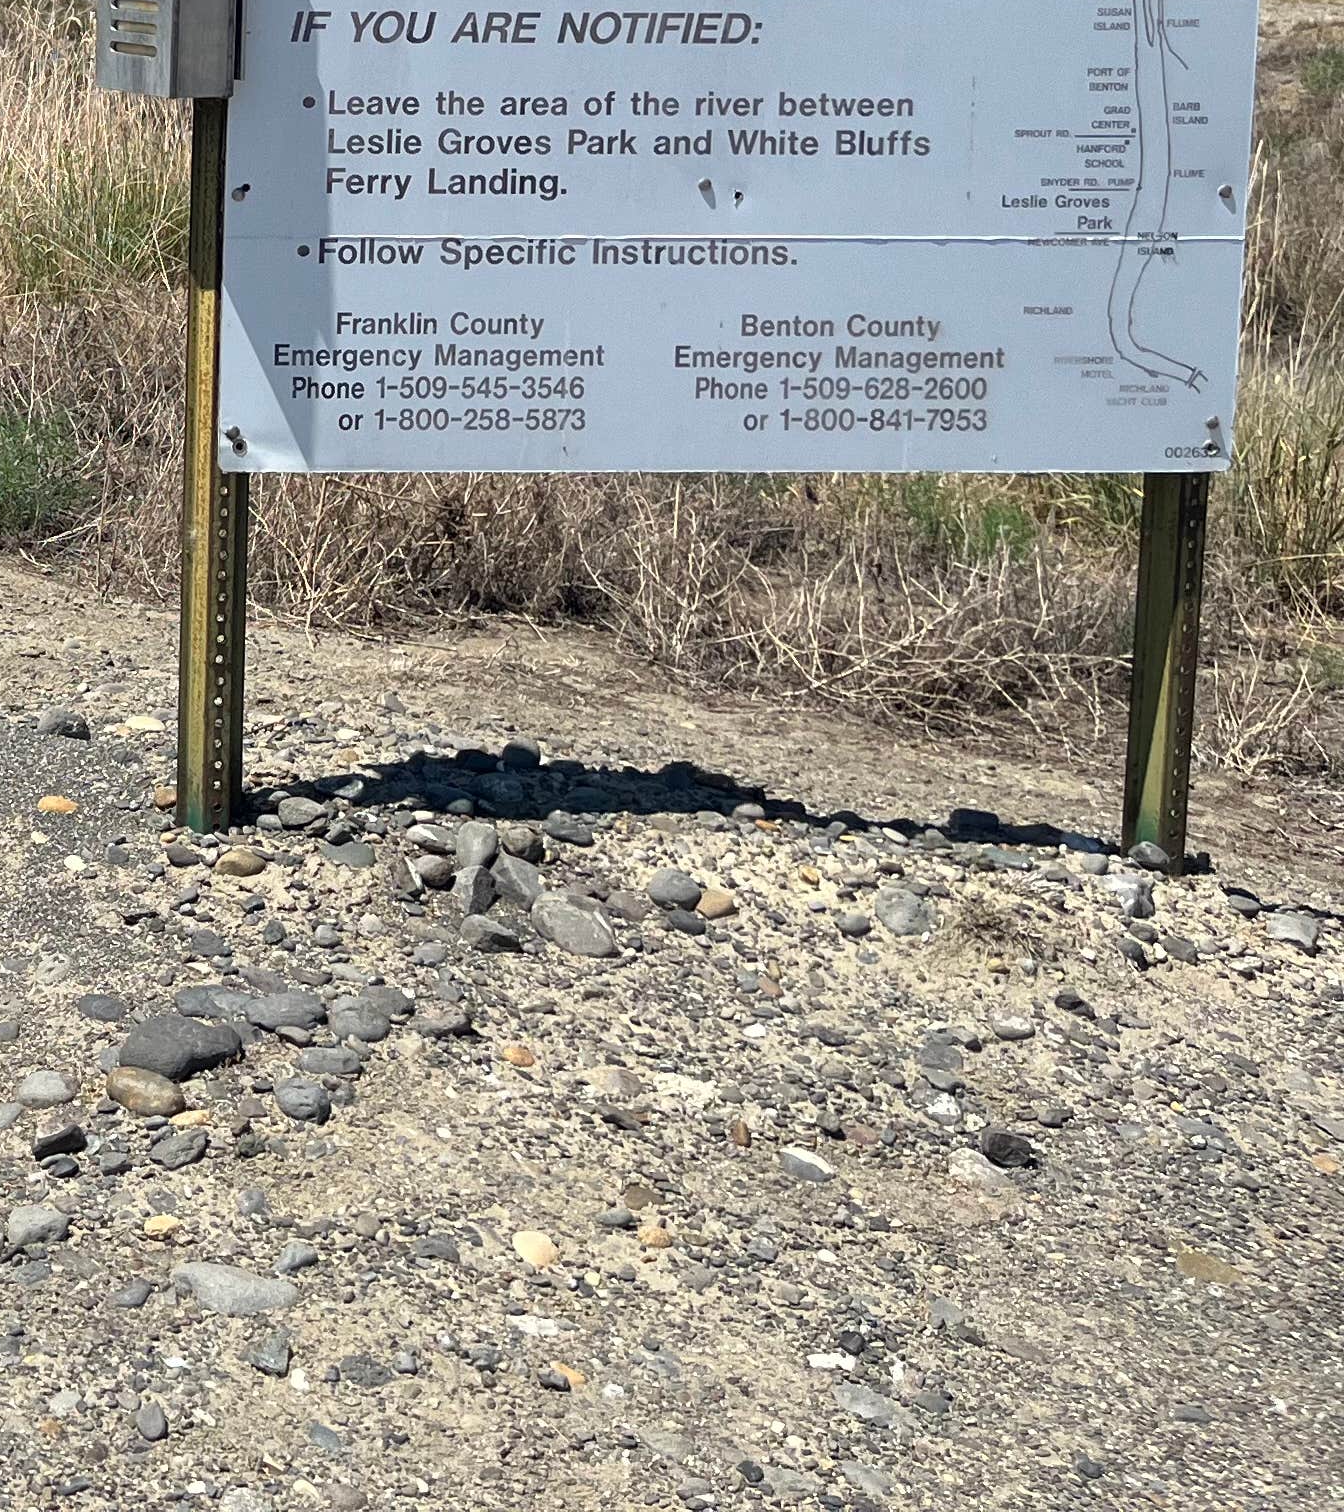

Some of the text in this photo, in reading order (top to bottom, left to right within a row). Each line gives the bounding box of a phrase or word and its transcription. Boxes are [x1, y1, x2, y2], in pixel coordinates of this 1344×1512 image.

[290, 9, 763, 45] IF YOU ARE NOTIFIED:
[1088, 82, 1129, 91] BENTON
[1076, 144, 1127, 154] HANFORD
[1001, 194, 1111, 209] Leslie Groves
[1077, 215, 1113, 230] Park
[336, 310, 545, 339] Franklin County
[273, 342, 605, 373] Emergency Management
[291, 374, 585, 400] Phone 1-509-545-3546
[338, 406, 586, 431] or 1-800-258-5873
